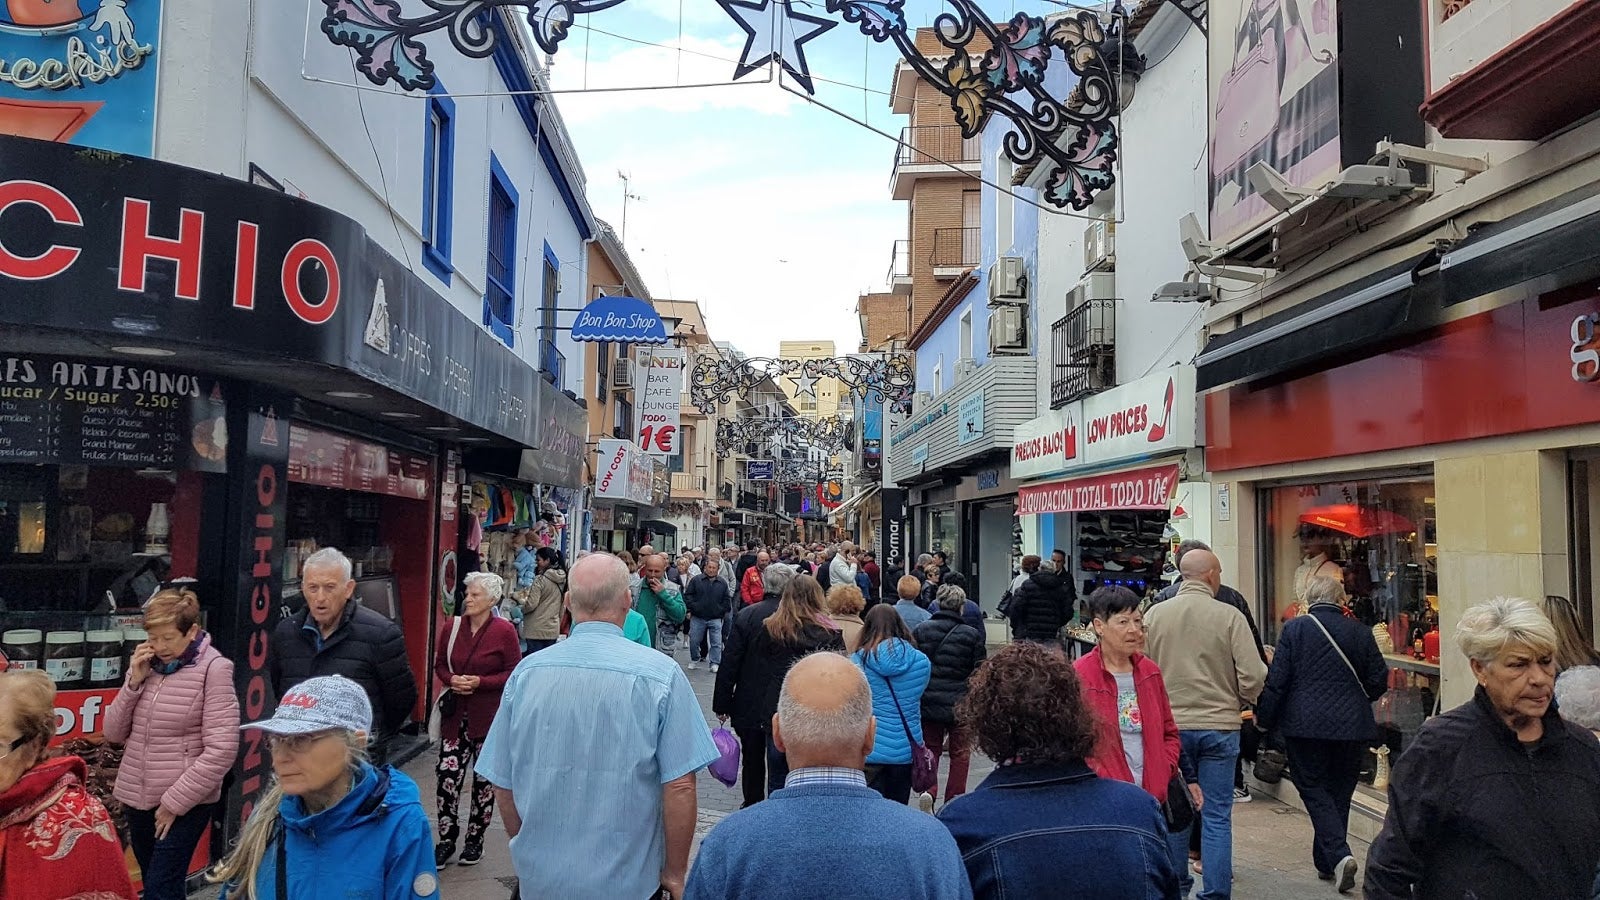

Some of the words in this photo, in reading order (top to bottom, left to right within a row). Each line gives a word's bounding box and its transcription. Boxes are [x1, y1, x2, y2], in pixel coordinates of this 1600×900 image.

[0, 36, 153, 89] cchio
[579, 311, 603, 328] Bon
[604, 311, 627, 328] Bon
[627, 313, 656, 333] Shop
[0, 358, 37, 383] ES
[52, 361, 199, 397] ARTESANOS
[648, 375, 669, 383] BAR
[64, 388, 119, 404] Sugar
[646, 387, 672, 396] CAFÉ
[637, 401, 679, 410] LOUNGE
[642, 414, 667, 422] TODO
[1087, 415, 1109, 445] LOW
[1110, 403, 1148, 439] PRICES
[82, 439, 106, 449] Grand
[640, 425, 676, 452] 1€
[1015, 437, 1041, 463] PRECIOS
[598, 471, 614, 493] LOW
[610, 446, 627, 471] COST
[1020, 483, 1073, 513] LIQUIDACIÓN
[1075, 485, 1107, 509] TOTAL
[1110, 479, 1143, 506] TODO
[54, 696, 112, 736] of
